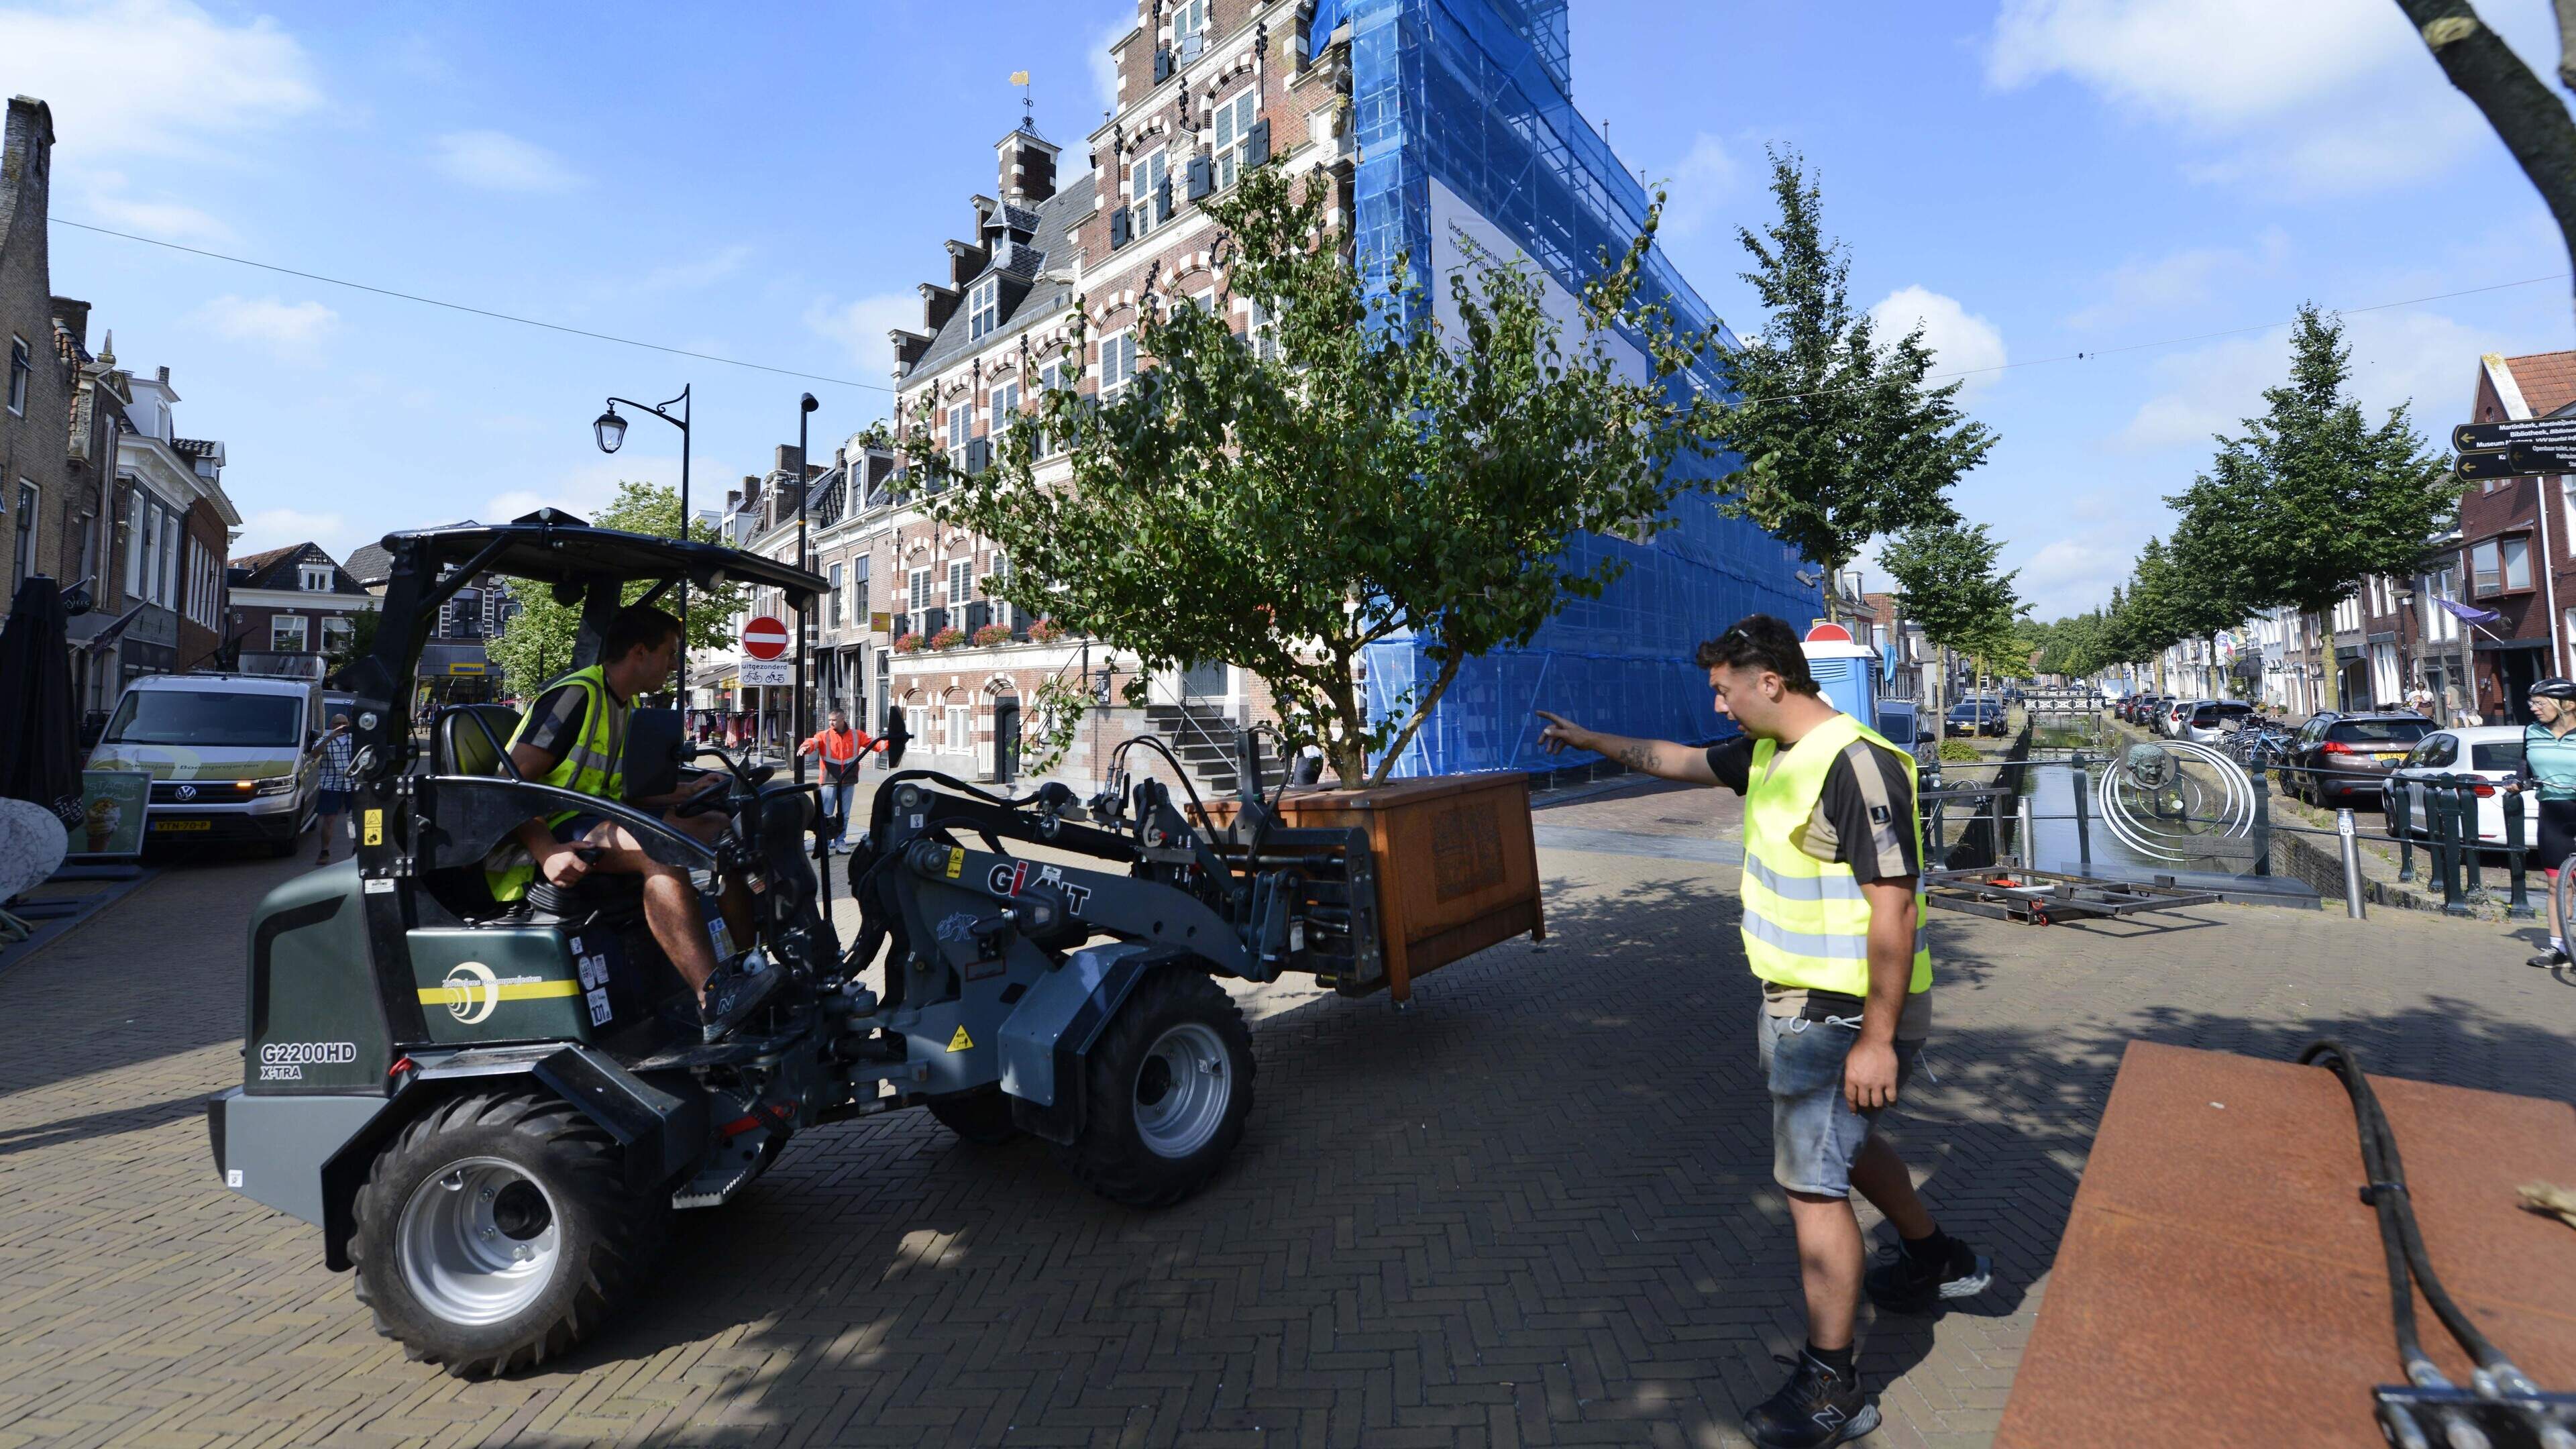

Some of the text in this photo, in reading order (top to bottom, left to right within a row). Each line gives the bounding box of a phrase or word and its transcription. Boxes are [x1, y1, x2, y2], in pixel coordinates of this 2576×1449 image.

[1448, 236, 1458, 250] Yn
[1481, 247, 1493, 260] oan
[1493, 252, 1497, 264] it
[2499, 422, 2538, 431] Martinikerk,
[2510, 429, 2548, 437] Bibliotheek,
[123, 763, 259, 771] Zoontjens Boomprojecten
[86, 780, 140, 790] ISTACHE
[260, 1042, 357, 1065] G2200HD
[260, 1065, 303, 1080] X-TRA
